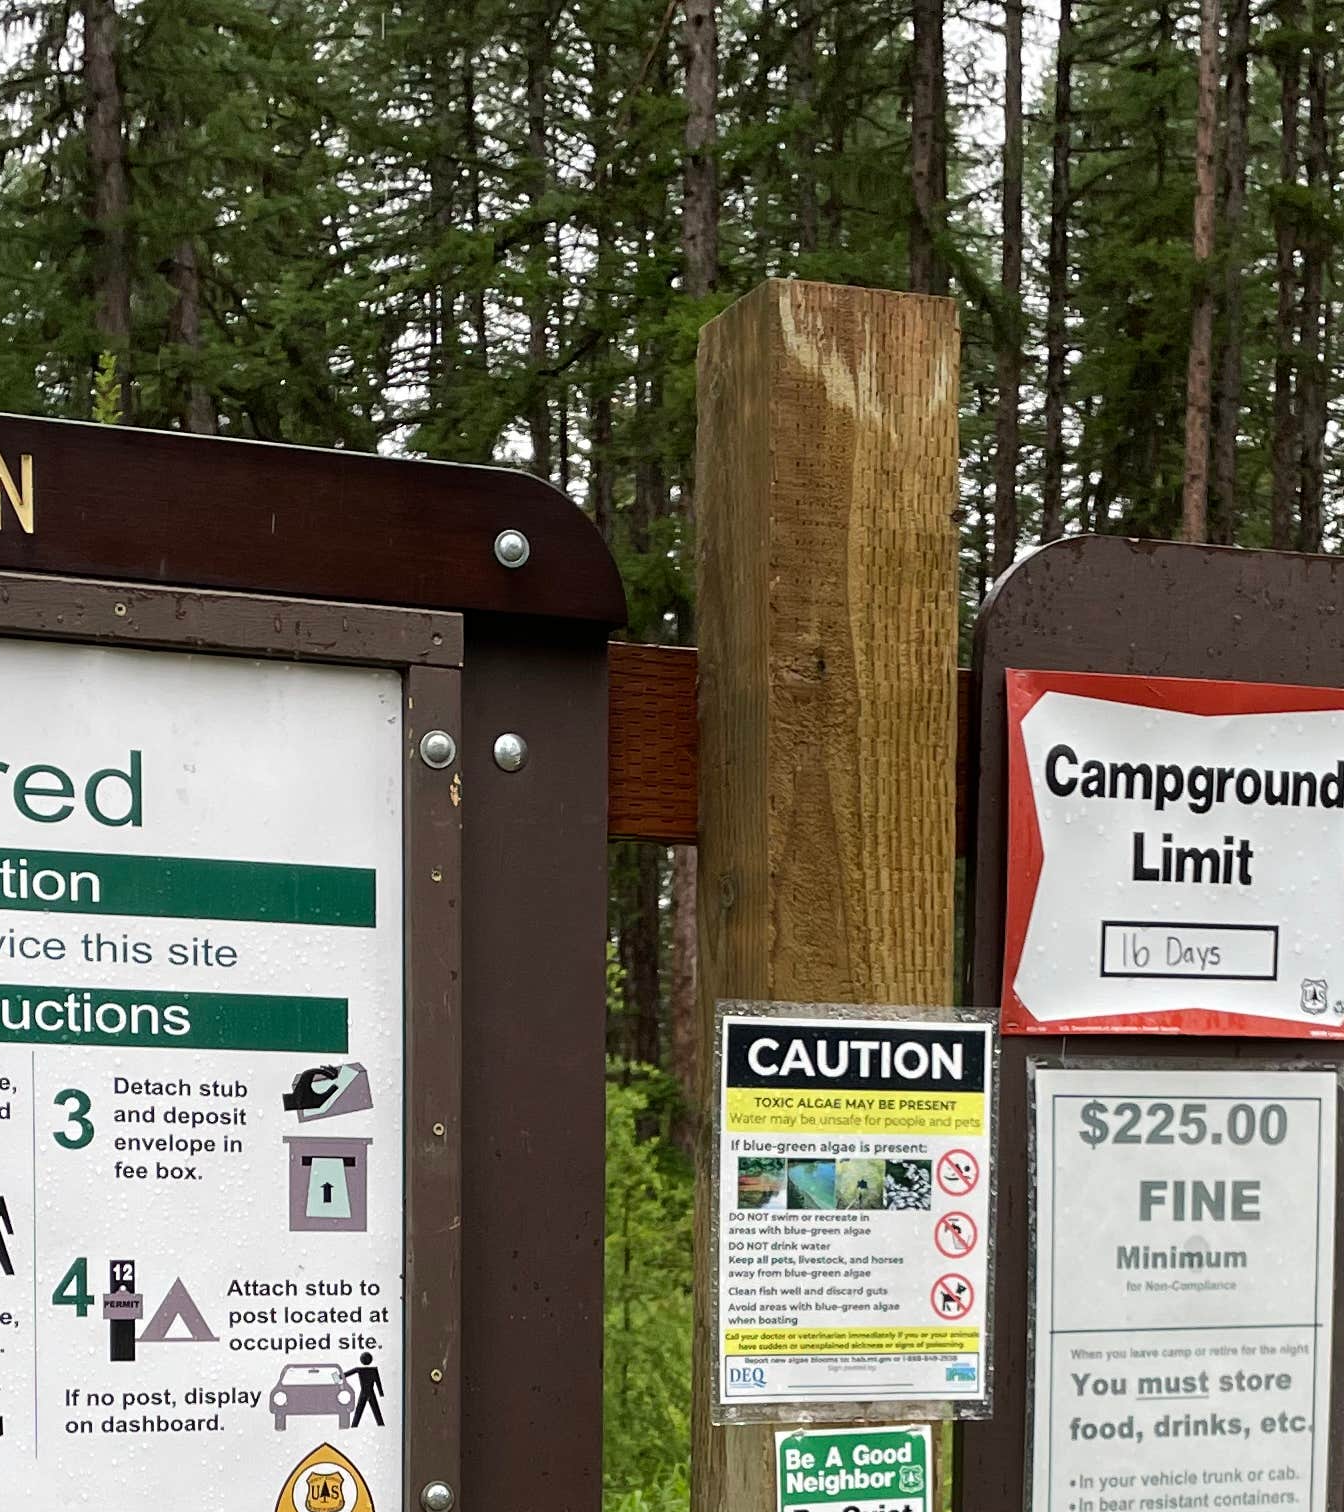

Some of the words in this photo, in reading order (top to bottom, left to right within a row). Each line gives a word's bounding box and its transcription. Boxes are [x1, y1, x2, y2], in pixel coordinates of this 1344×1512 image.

[1046, 745, 1344, 814] Campground
[1133, 832, 1253, 885] Limit
[81, 933, 152, 963] this
[168, 938, 237, 967] site
[1123, 933, 1150, 967] 16
[1167, 937, 1220, 970] Days
[748, 1038, 962, 1079] CAUTION
[754, 1098, 793, 1108] TOXIC
[797, 1098, 841, 1108] ALGAE
[846, 1100, 874, 1109] MAY
[879, 1100, 894, 1109] BE
[900, 1100, 956, 1110] PRESENT
[1080, 1100, 1287, 1150] $225.00
[1140, 1181, 1260, 1221] FINE
[1117, 1246, 1246, 1269] Minimum
[1071, 1373, 1126, 1396] You
[1138, 1372, 1208, 1394] must
[1220, 1371, 1291, 1392] store
[1070, 1416, 1143, 1443] food,
[1154, 1414, 1250, 1438] drinks,
[1260, 1412, 1313, 1433] etc.
[786, 1449, 814, 1470] Be
[825, 1447, 842, 1467] A
[853, 1442, 911, 1465] Good
[787, 1469, 895, 1495] Neighbor
